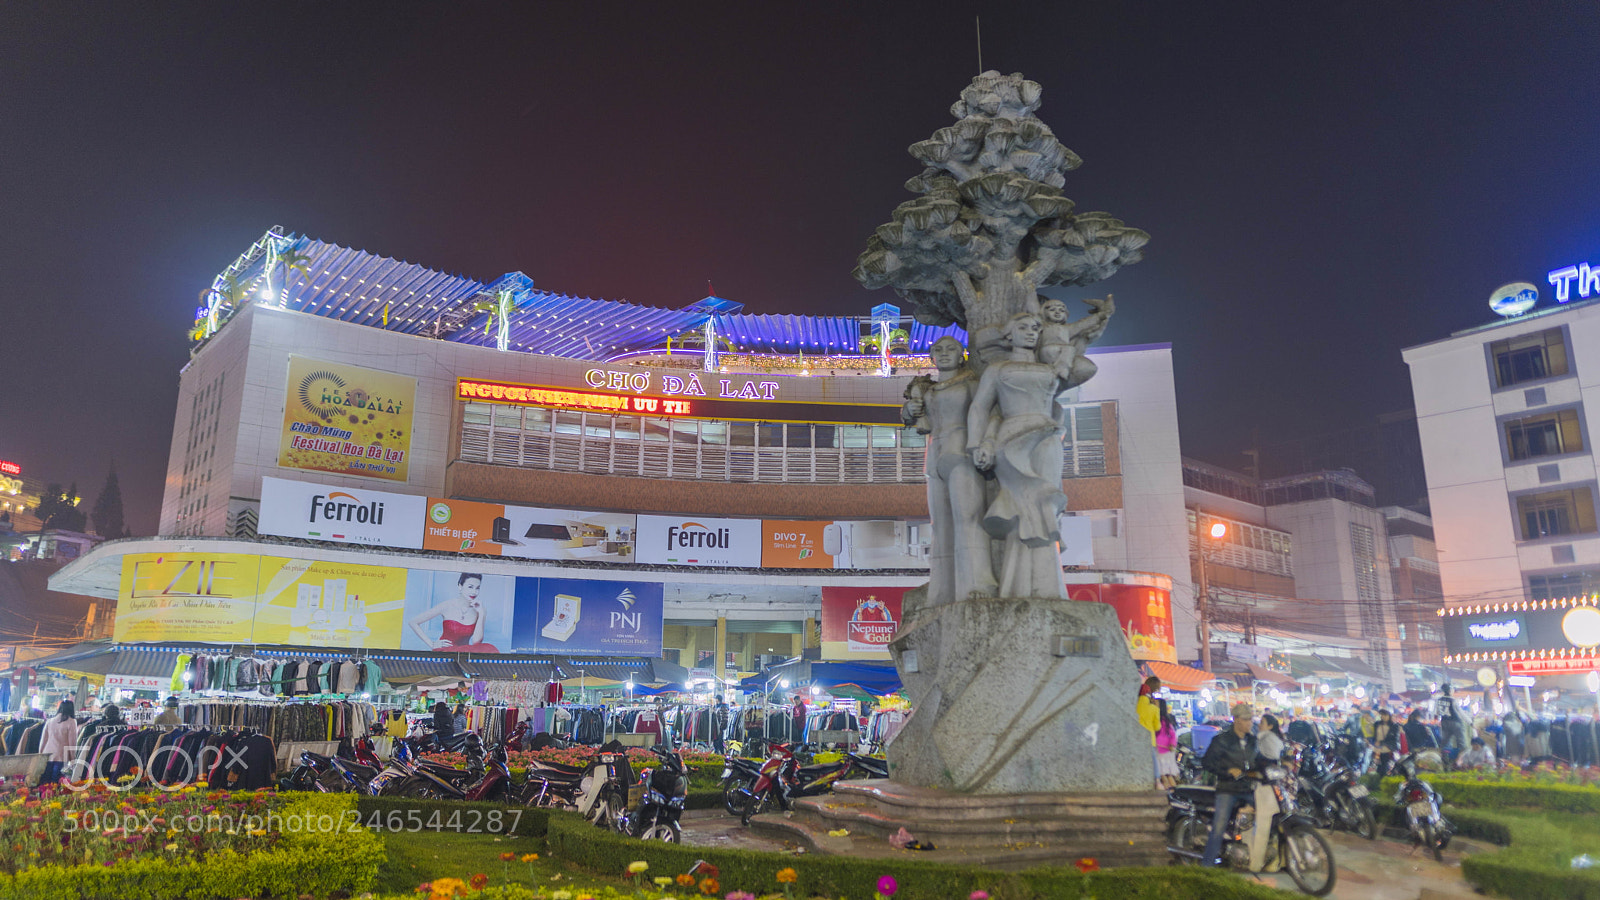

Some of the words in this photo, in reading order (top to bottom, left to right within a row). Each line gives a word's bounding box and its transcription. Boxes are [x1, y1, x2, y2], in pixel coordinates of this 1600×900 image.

[585, 368, 651, 394] CHỢ
[662, 372, 706, 396] ĐÀ
[321, 393, 352, 407] HOA
[323, 387, 403, 406] FESTIVAL
[290, 421, 320, 434] Chào
[321, 426, 353, 440] Mừng
[292, 435, 341, 454] Festival
[342, 443, 365, 457] Hoa
[366, 445, 383, 459] Đà
[384, 447, 405, 464] Lạt
[309, 494, 385, 525] Ferroli
[354, 535, 381, 543] ITALIA
[429, 526, 452, 537] THIẾT
[452, 530, 461, 539] BỊ
[461, 528, 478, 539] BẾP
[667, 526, 730, 551] Ferroli
[774, 532, 797, 541] DIVO
[799, 533, 806, 545] 7
[610, 611, 642, 633] PNJ
[851, 623, 893, 635] Neptune
[867, 633, 891, 643] Gold
